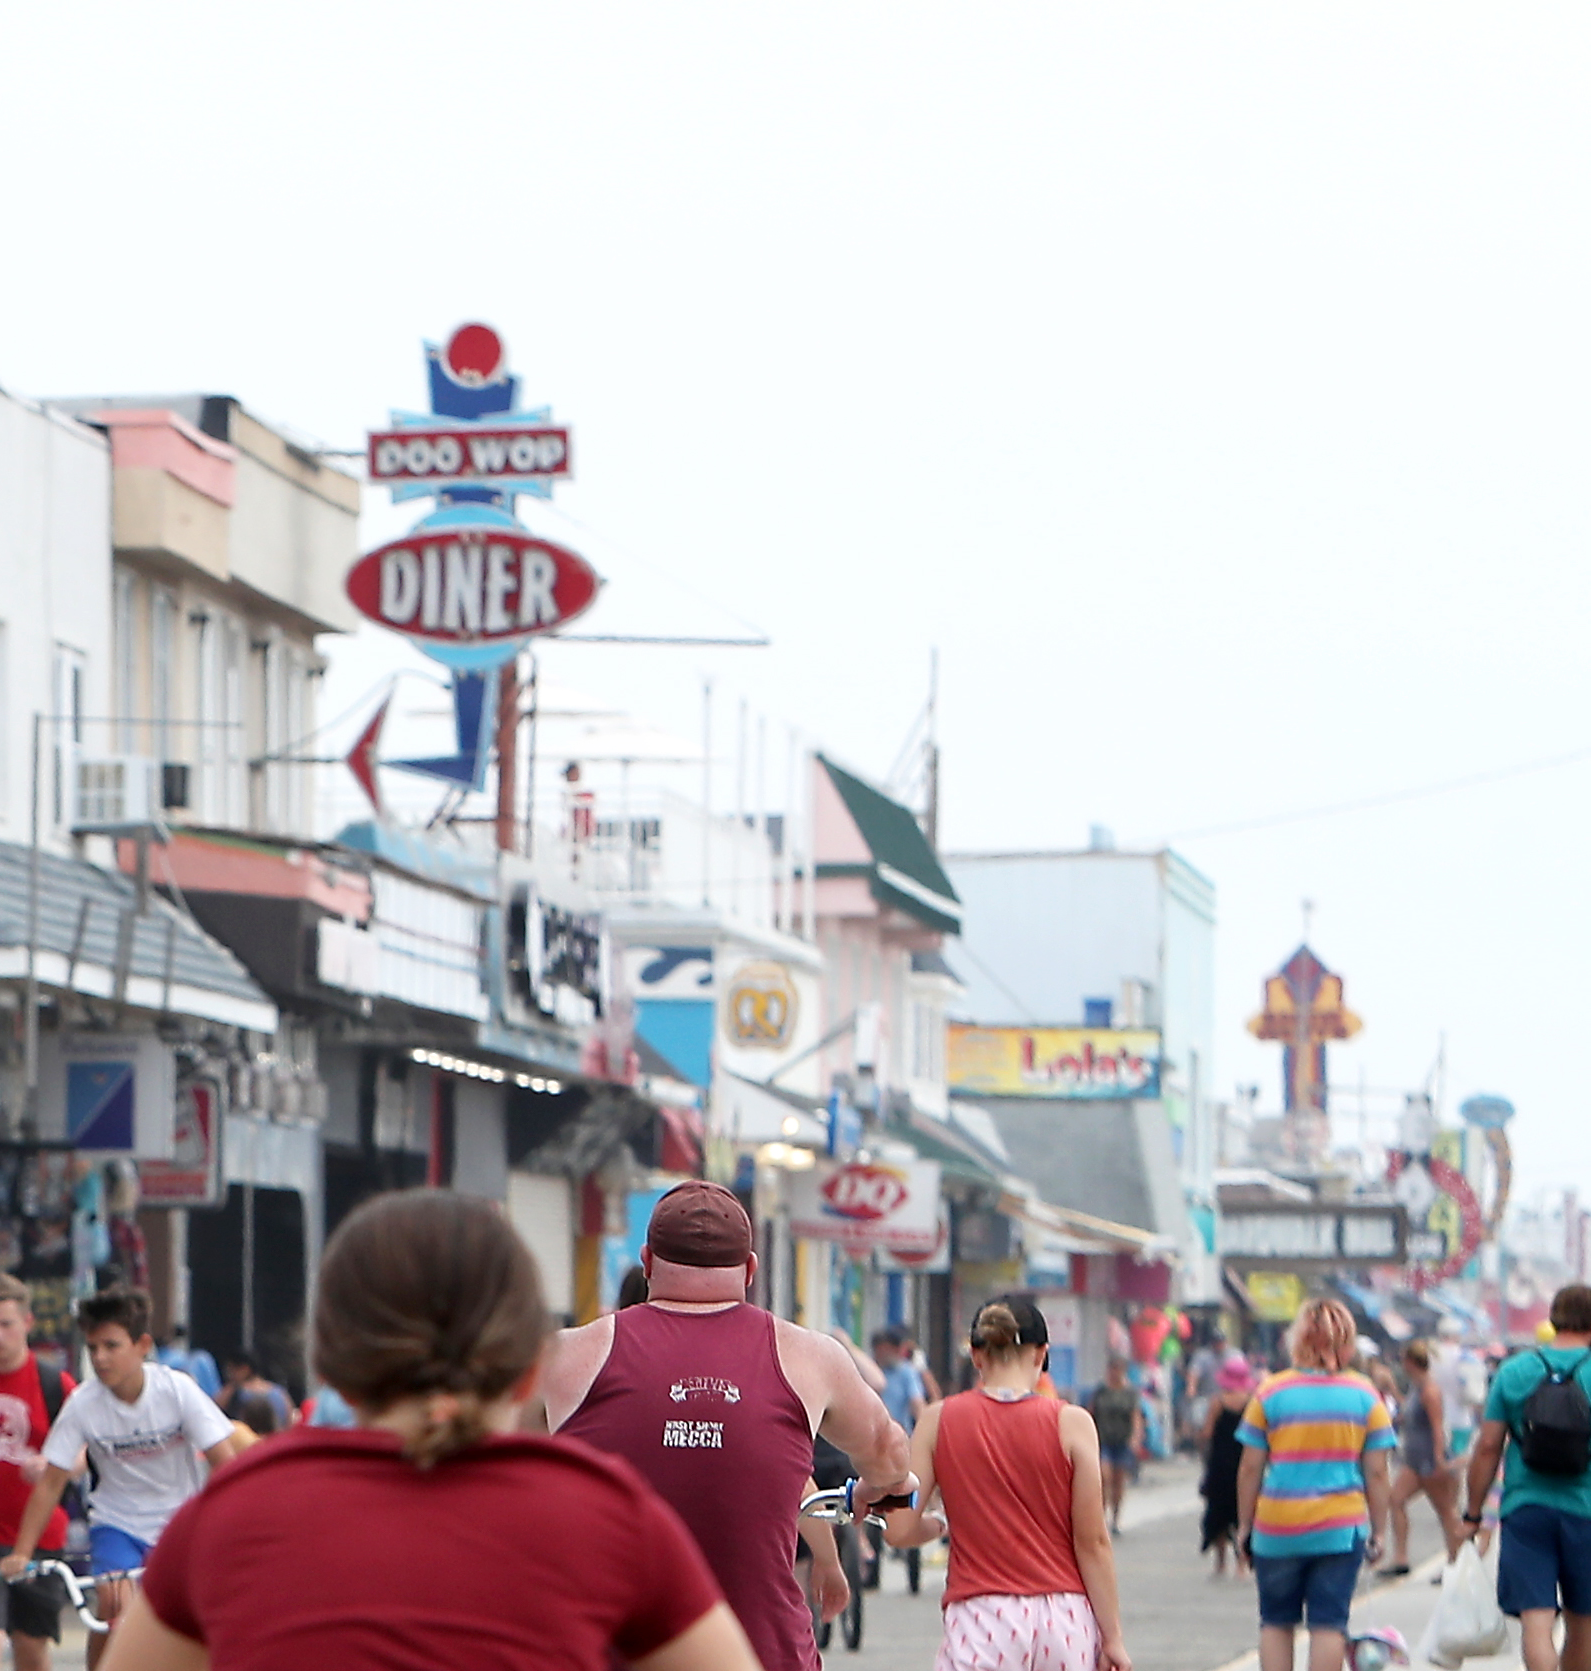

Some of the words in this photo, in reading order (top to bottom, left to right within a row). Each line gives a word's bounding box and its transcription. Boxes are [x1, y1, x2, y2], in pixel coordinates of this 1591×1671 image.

[375, 440, 462, 476] DOO
[468, 435, 565, 472] WOP
[379, 544, 561, 634] DINER
[662, 1429, 724, 1449] MECCA
